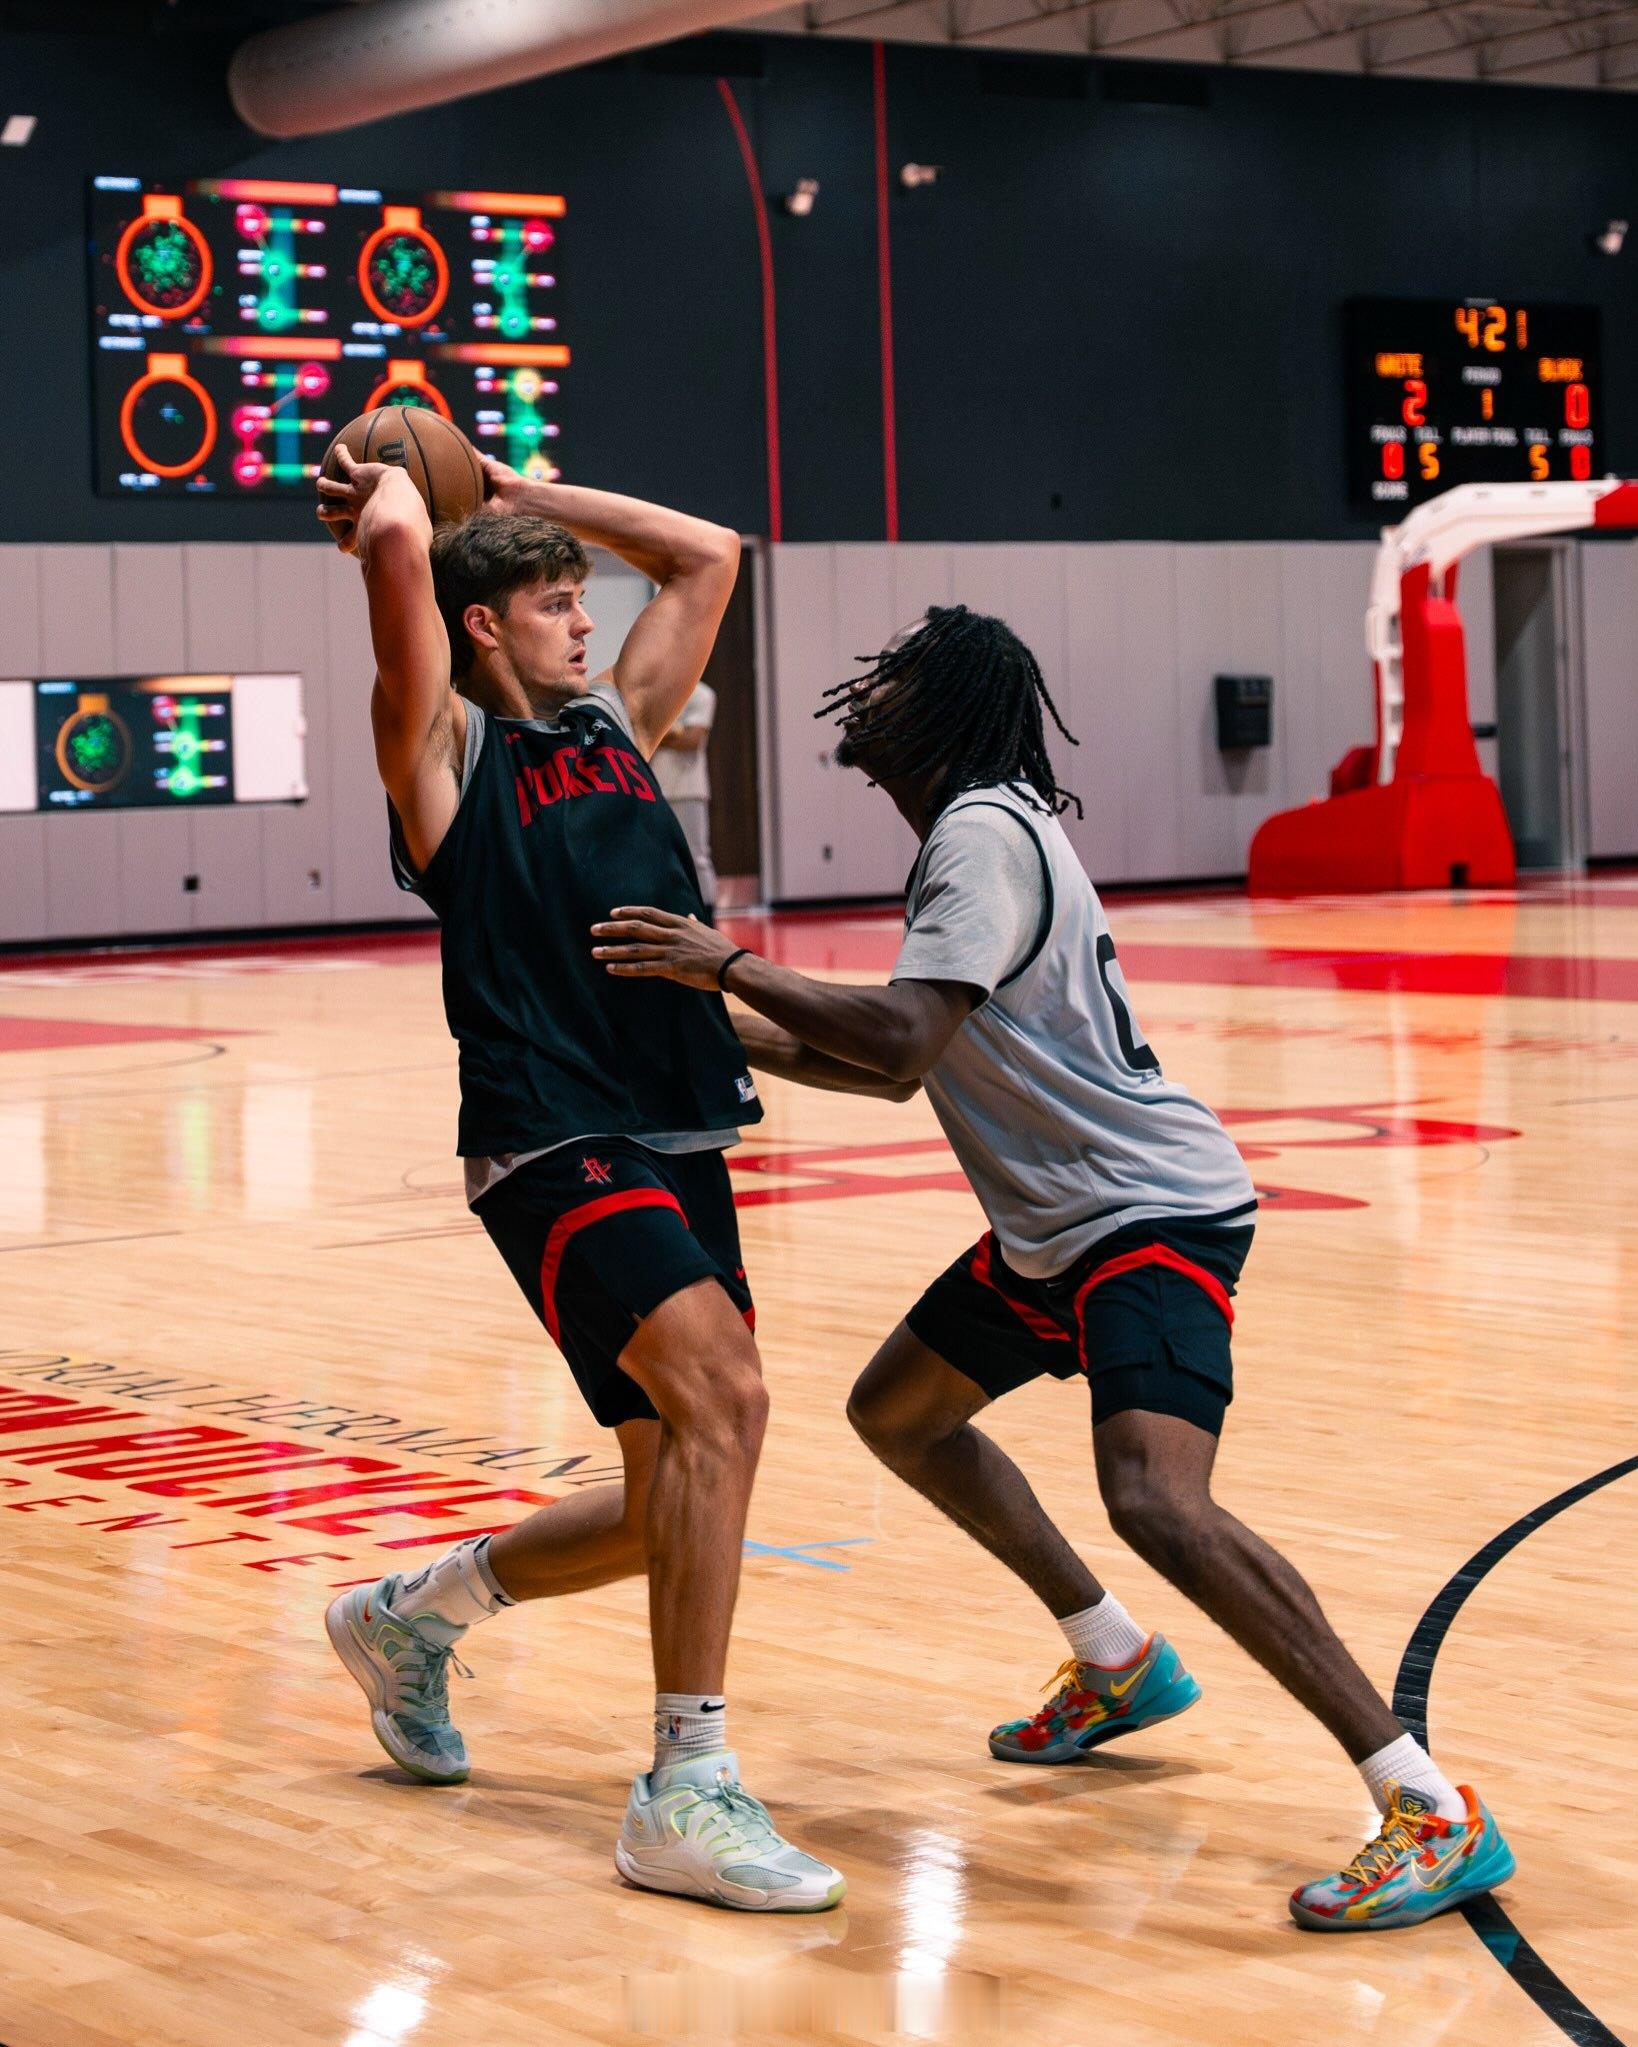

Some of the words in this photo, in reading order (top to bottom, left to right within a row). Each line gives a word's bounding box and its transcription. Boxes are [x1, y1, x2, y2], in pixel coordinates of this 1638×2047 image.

[1402, 380, 1427, 427] 2
[1481, 388, 1493, 420] 1
[1565, 383, 1590, 429] 0
[1382, 441, 1405, 480] 0
[1418, 442, 1440, 480] 5
[1529, 443, 1549, 480] 5
